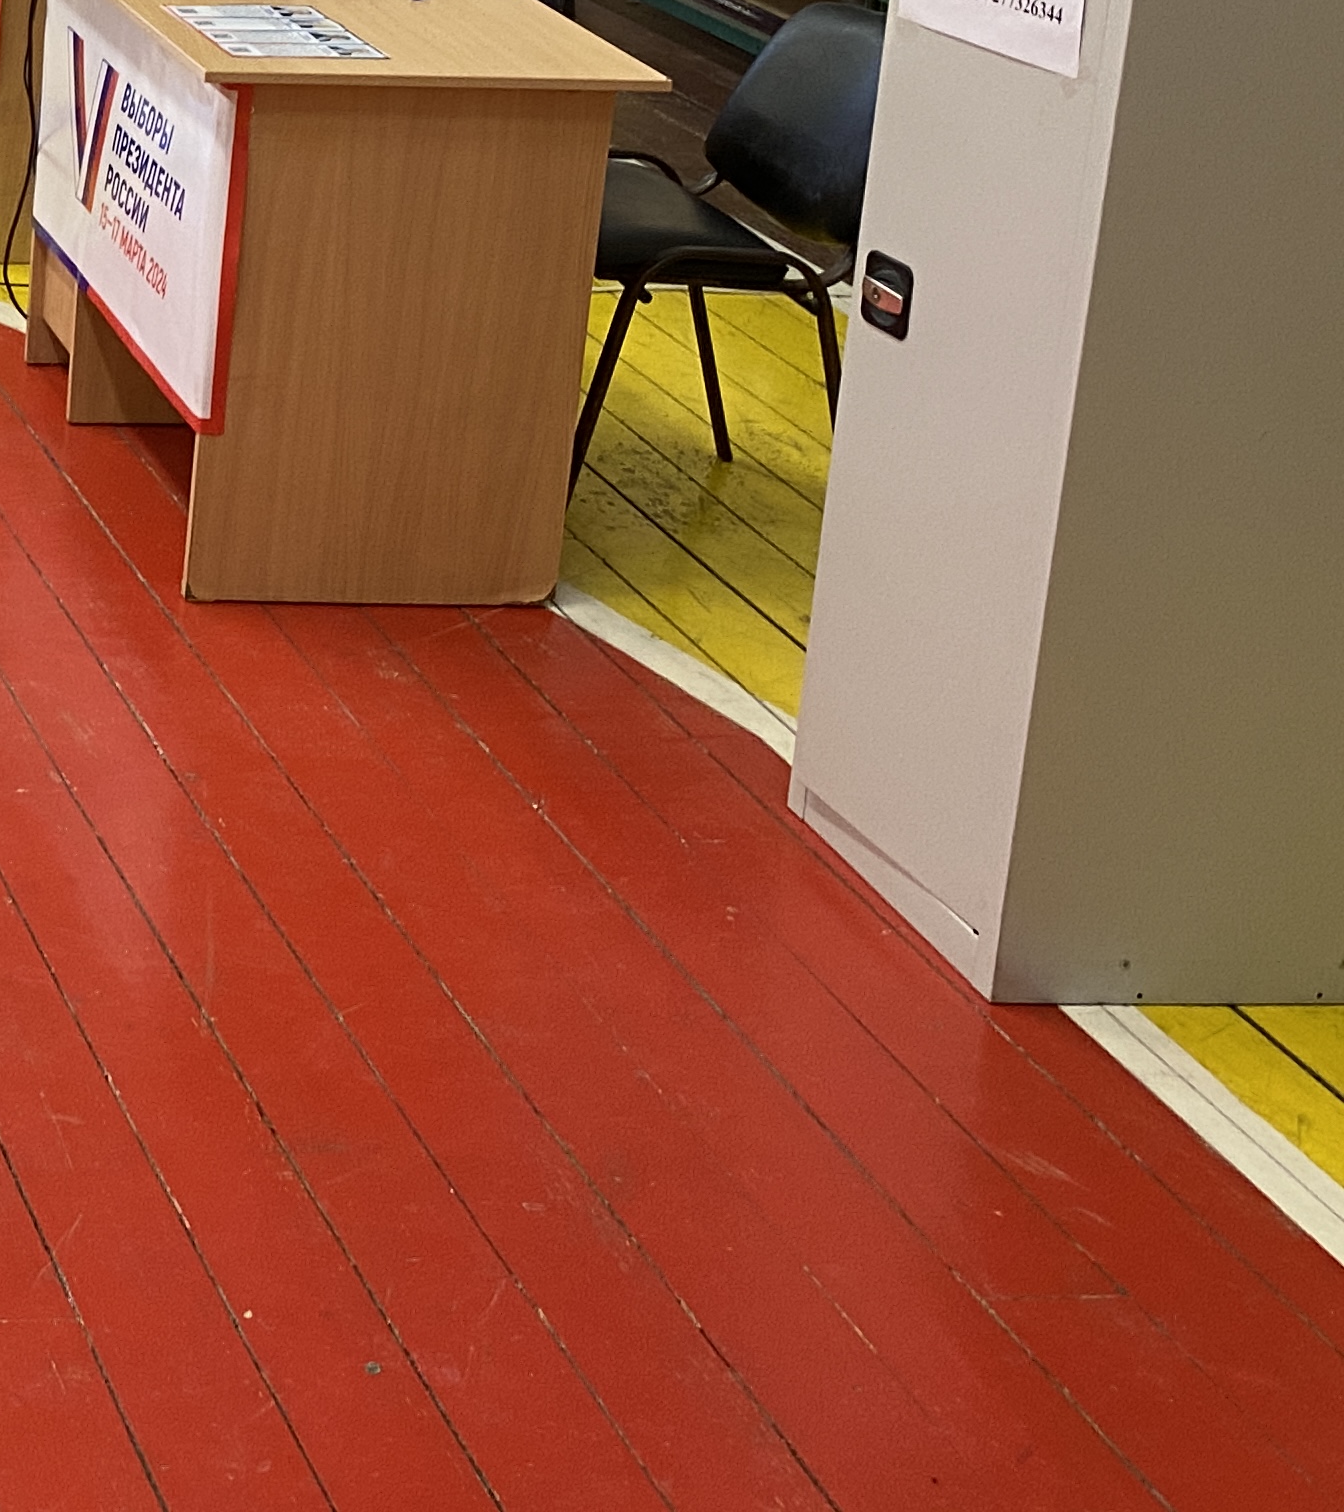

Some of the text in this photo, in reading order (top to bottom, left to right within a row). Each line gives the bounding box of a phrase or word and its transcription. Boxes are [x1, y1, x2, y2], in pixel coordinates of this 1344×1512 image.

[121, 83, 175, 155] ВЫБОРЫ
[104, 164, 151, 233] РОССИИ
[112, 123, 186, 221] ПРЕЗИДЕНТА
[119, 226, 147, 278] МАРТА
[146, 257, 169, 299] 2024
